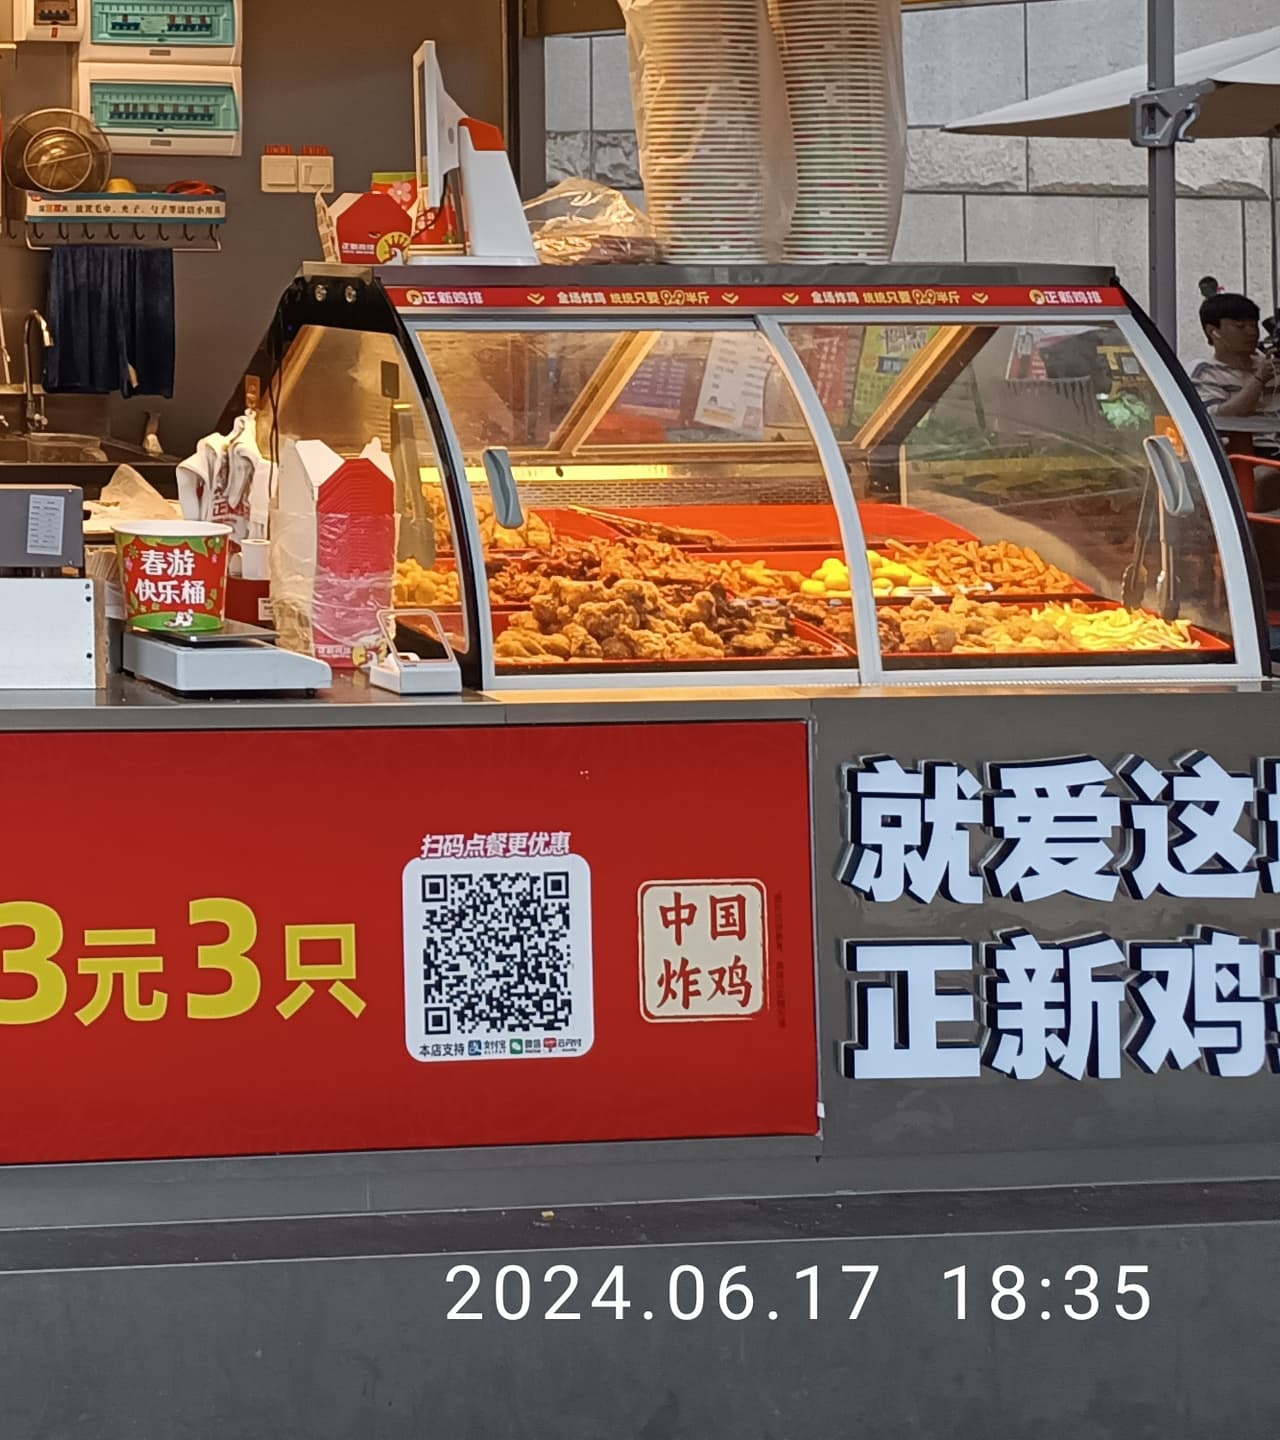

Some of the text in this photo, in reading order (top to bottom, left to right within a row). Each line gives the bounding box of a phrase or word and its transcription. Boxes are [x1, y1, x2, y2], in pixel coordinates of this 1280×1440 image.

[423, 291, 484, 305] 正新鸡排
[1044, 290, 1103, 304] 正新鸡排
[139, 548, 196, 577] 春游
[134, 579, 207, 606] 快乐桶
[419, 830, 571, 859] 扫码点餐更优惠
[658, 890, 748, 947] 中国
[656, 955, 753, 1010] 炸鸡
[842, 930, 1280, 1082] 正新鸡
[419, 1043, 465, 1057] 本店支持
